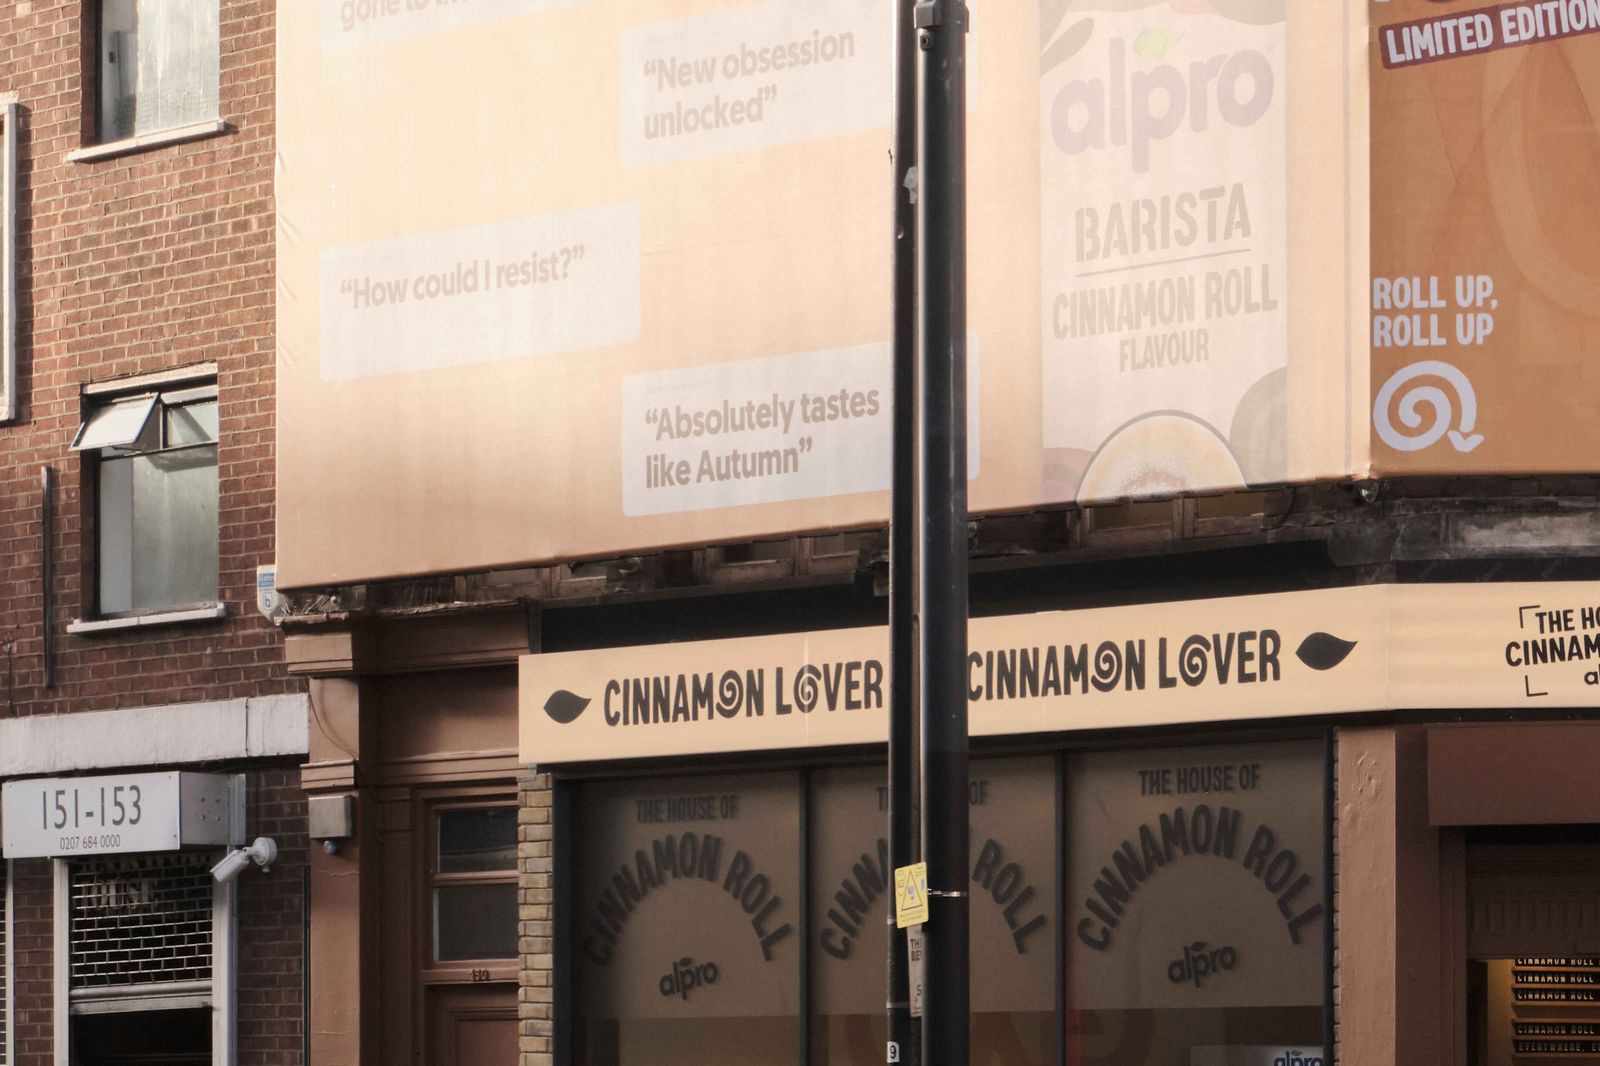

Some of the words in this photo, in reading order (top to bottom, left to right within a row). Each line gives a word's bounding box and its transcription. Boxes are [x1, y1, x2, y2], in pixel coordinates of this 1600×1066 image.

[722, 29, 855, 78] obsession
[1386, 13, 1494, 63] LIMITED
[1050, 36, 1275, 174] alpro
[1076, 183, 1251, 263] BARISTA
[413, 260, 478, 300] could
[485, 259, 491, 290] I
[1373, 275, 1446, 309] ROLL
[1455, 274, 1498, 309] UP,
[1052, 276, 1195, 340] CINNAMON
[1205, 263, 1278, 320] ROLL
[1119, 328, 1209, 372] FLAVOUR
[1373, 315, 1446, 347] ROLL
[1456, 313, 1494, 345] UP
[801, 388, 880, 424] tastes
[645, 453, 690, 489] like
[1535, 609, 1575, 634] THE
[604, 668, 765, 727] CINNAMON
[776, 659, 883, 714] LOVER
[967, 639, 1145, 701] CINNAMON
[1159, 629, 1281, 688] LOVER
[970, 780, 988, 806] OF
[1139, 768, 1170, 796] THE
[1176, 765, 1233, 794] HOUSE
[1239, 764, 1259, 790] OF
[43, 785, 141, 829] 151-153
[635, 799, 662, 823] THE
[667, 797, 717, 822] HOUSE
[720, 795, 738, 819] OF
[60, 837, 80, 850] 0207
[83, 836, 97, 849] 684
[100, 834, 121, 848] 0000
[1077, 804, 1240, 952] CINNAMON
[1242, 824, 1322, 946] ROLL
[581, 832, 724, 967] CINNAMON
[723, 850, 792, 962] ROLL
[820, 838, 888, 960] CINN
[971, 839, 1047, 955] ROLL
[659, 961, 719, 1000] alpro
[1167, 945, 1237, 988] alpro
[1517, 973, 1566, 984] CINNAMON
[1571, 973, 1595, 984] ROLL
[1517, 990, 1566, 1000] CINNAMON
[1571, 990, 1595, 1000] ROLL
[1517, 1025, 1566, 1035] CINNAMON
[1571, 1025, 1595, 1035] ROLL
